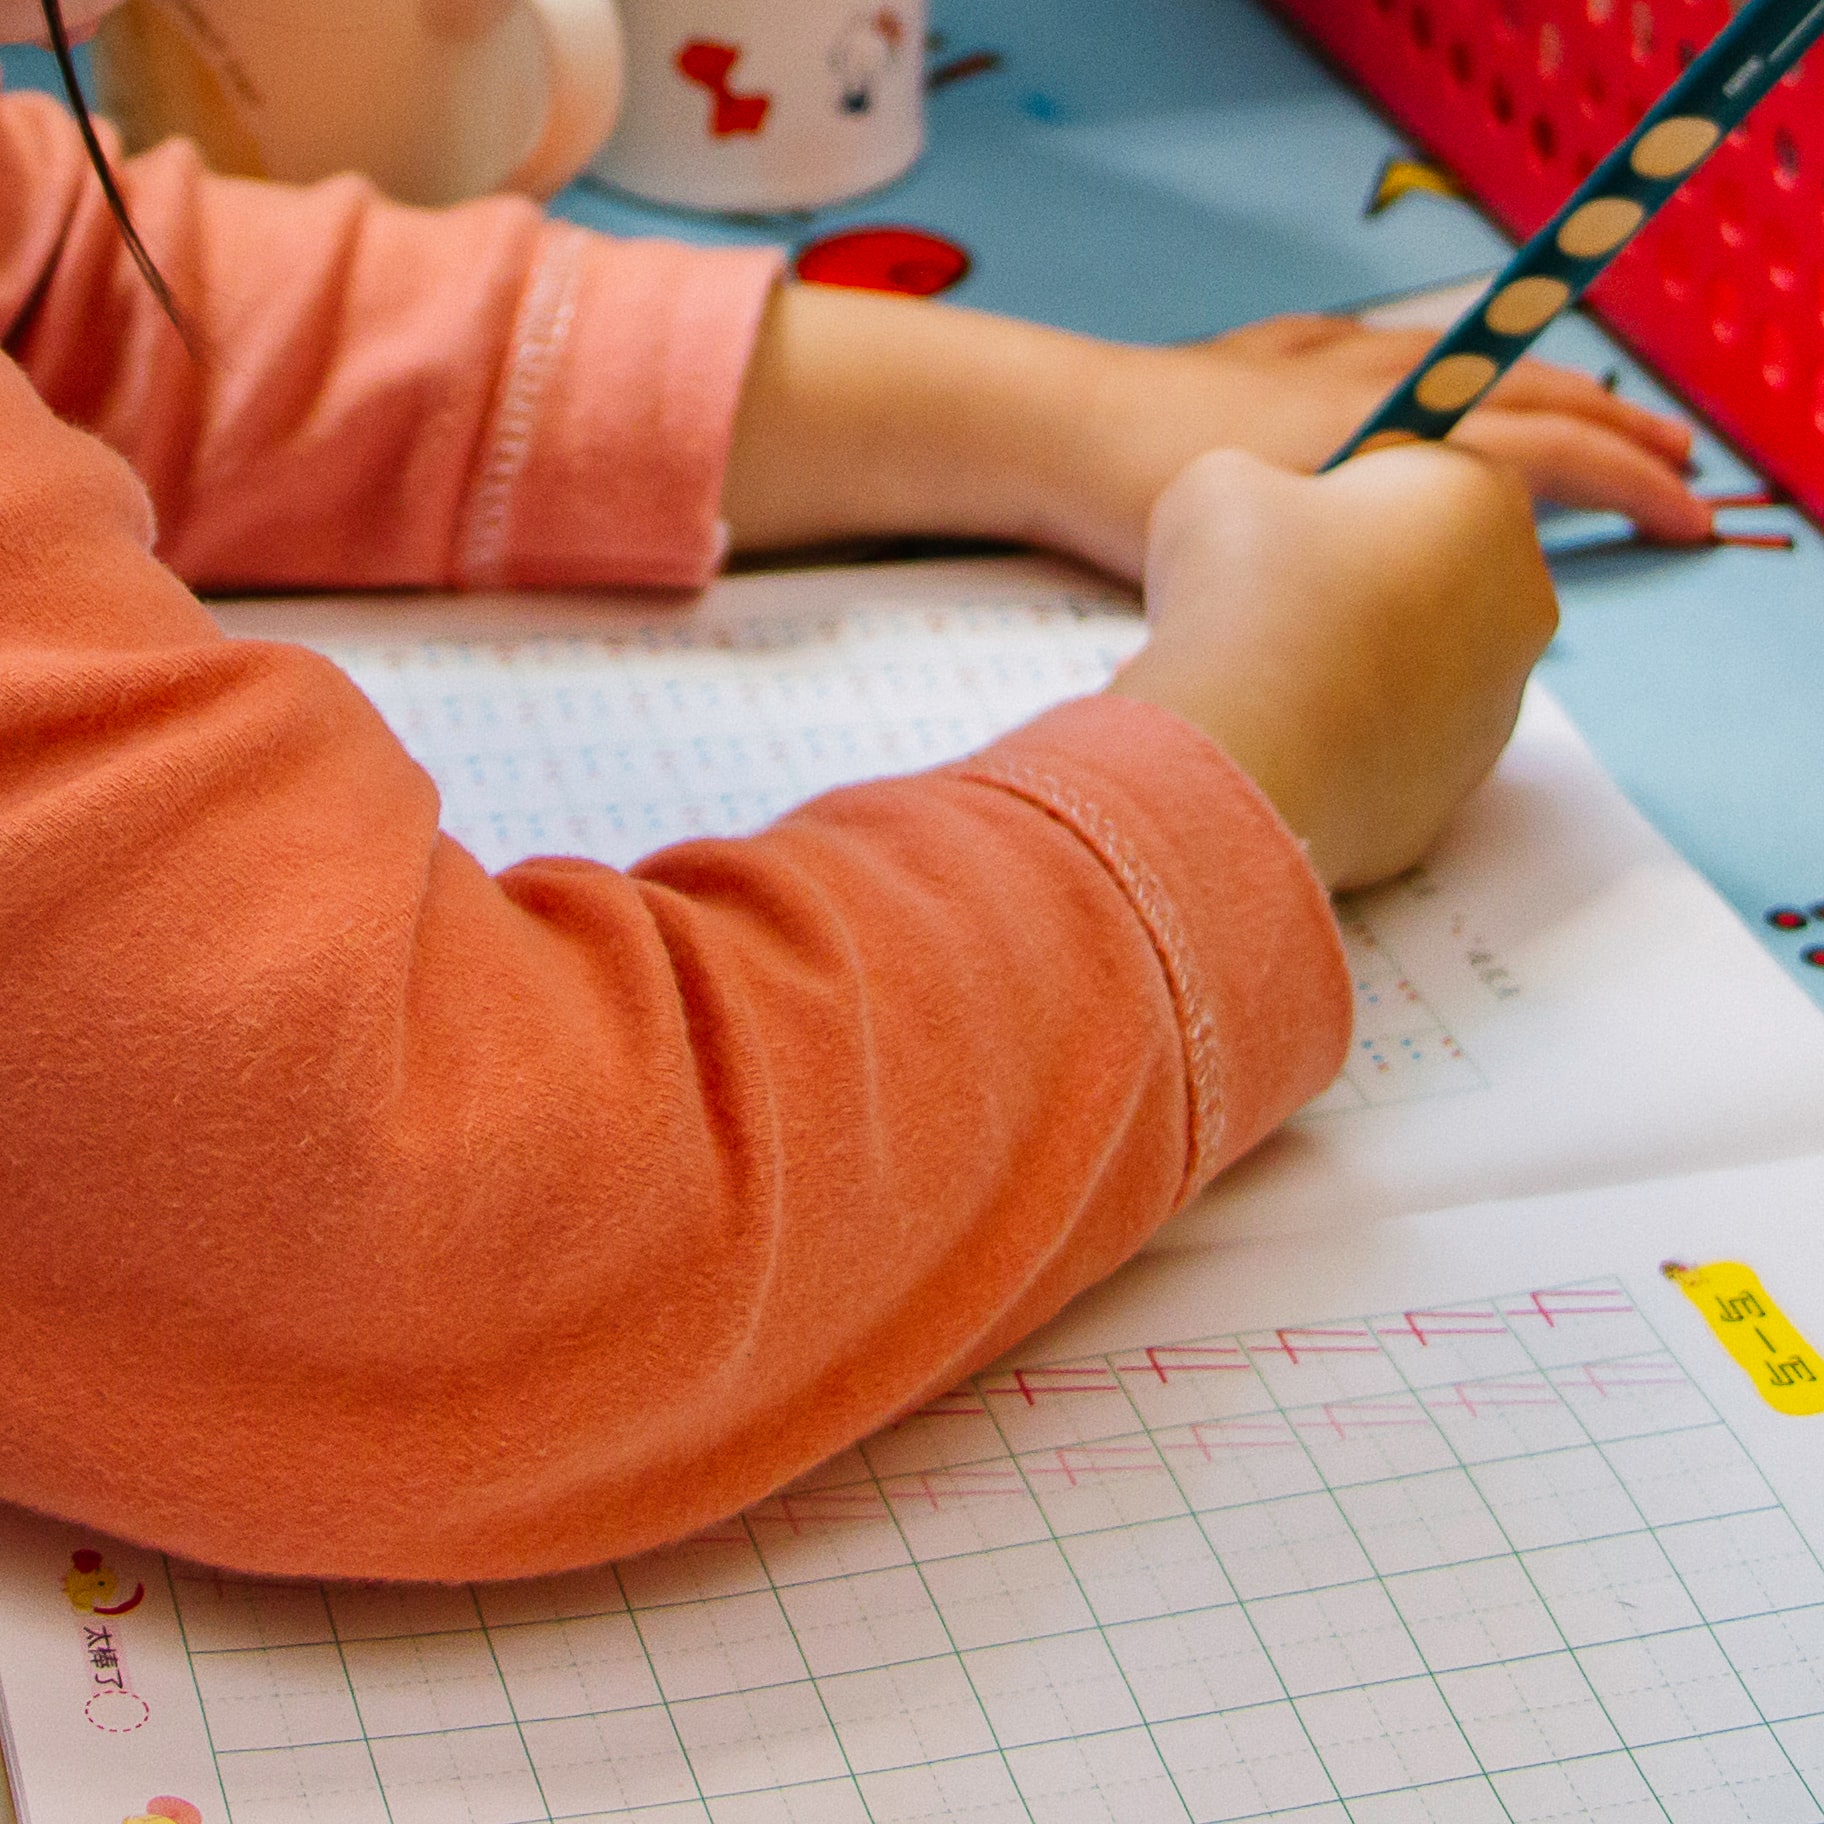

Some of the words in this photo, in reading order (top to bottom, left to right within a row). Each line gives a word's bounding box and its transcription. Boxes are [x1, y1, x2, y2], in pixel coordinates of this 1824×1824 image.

[1715, 1290, 1817, 1386] 写一写
[83, 1624, 123, 1689] 太棒了
